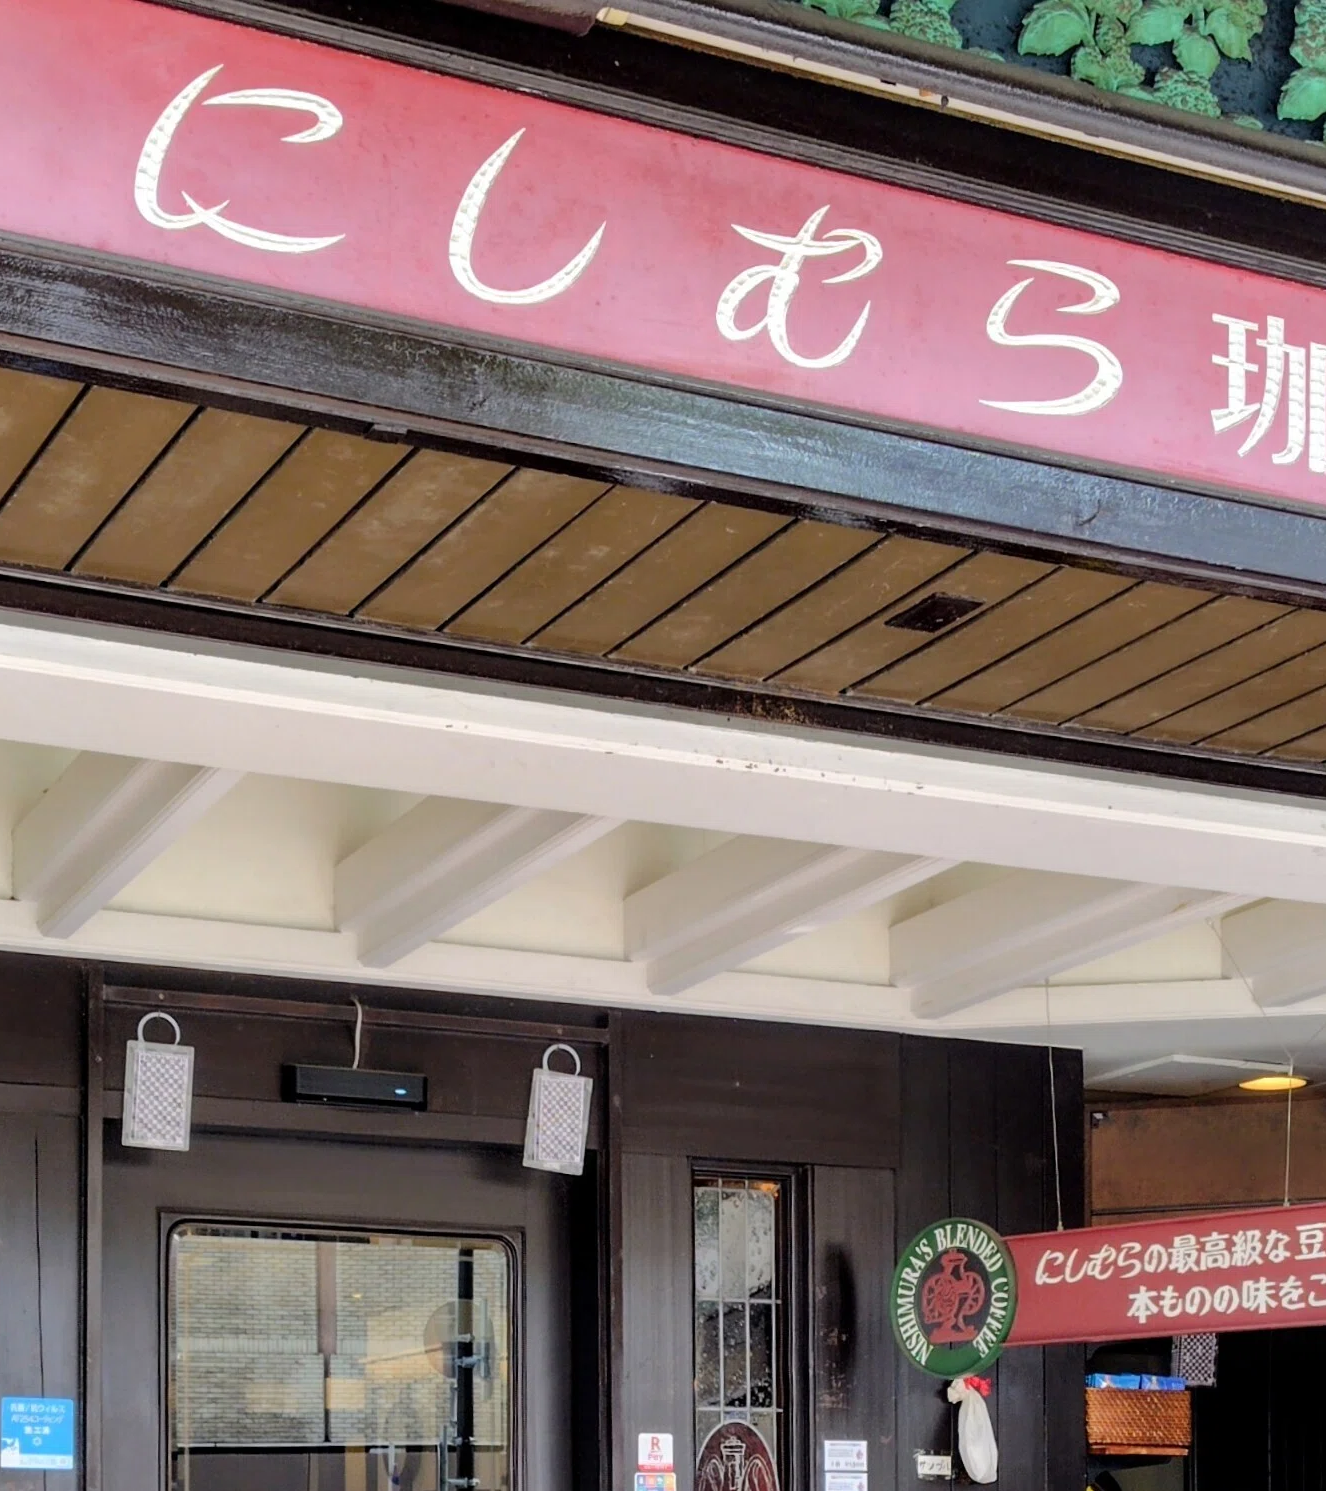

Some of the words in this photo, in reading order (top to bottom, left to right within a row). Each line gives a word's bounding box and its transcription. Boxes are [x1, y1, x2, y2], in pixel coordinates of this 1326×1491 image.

[897, 1238, 934, 1366] NISHIMURA'S
[934, 1224, 1004, 1272] BLENDED
[973, 1277, 1009, 1358] COFFEE
